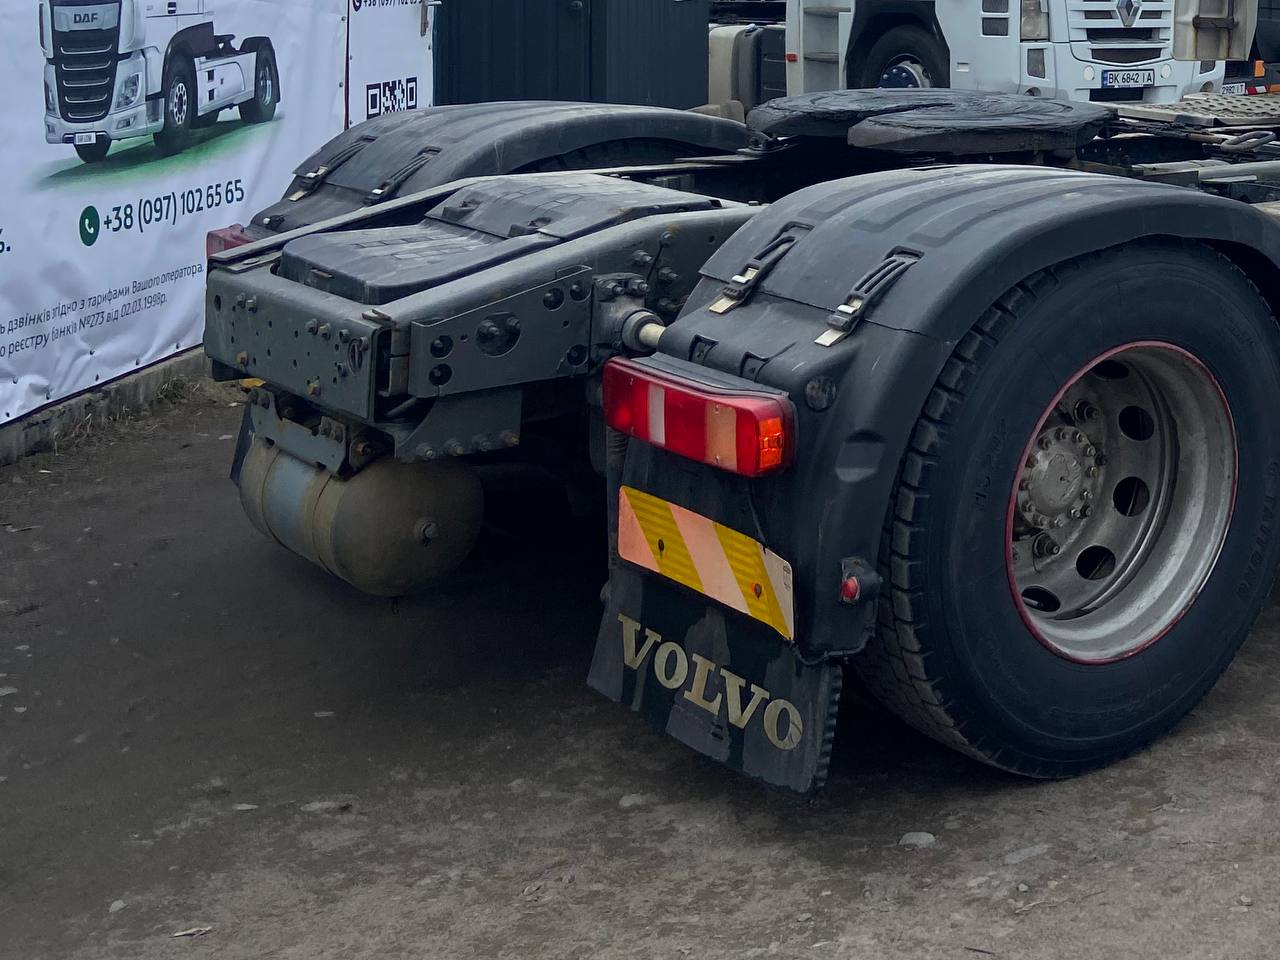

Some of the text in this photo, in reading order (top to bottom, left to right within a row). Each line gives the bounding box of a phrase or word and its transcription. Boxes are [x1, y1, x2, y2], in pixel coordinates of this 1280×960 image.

[74, 12, 98, 24] DAF
[1108, 73, 1119, 84] BK
[1121, 72, 1140, 83] 6842
[104, 179, 244, 233] +38 (097) 102 65 65
[7, 308, 51, 335] дзвінків
[87, 286, 130, 309] тарифами
[8, 333, 50, 358] реєстру
[106, 308, 119, 323] від
[618, 613, 803, 750] VOLVO
